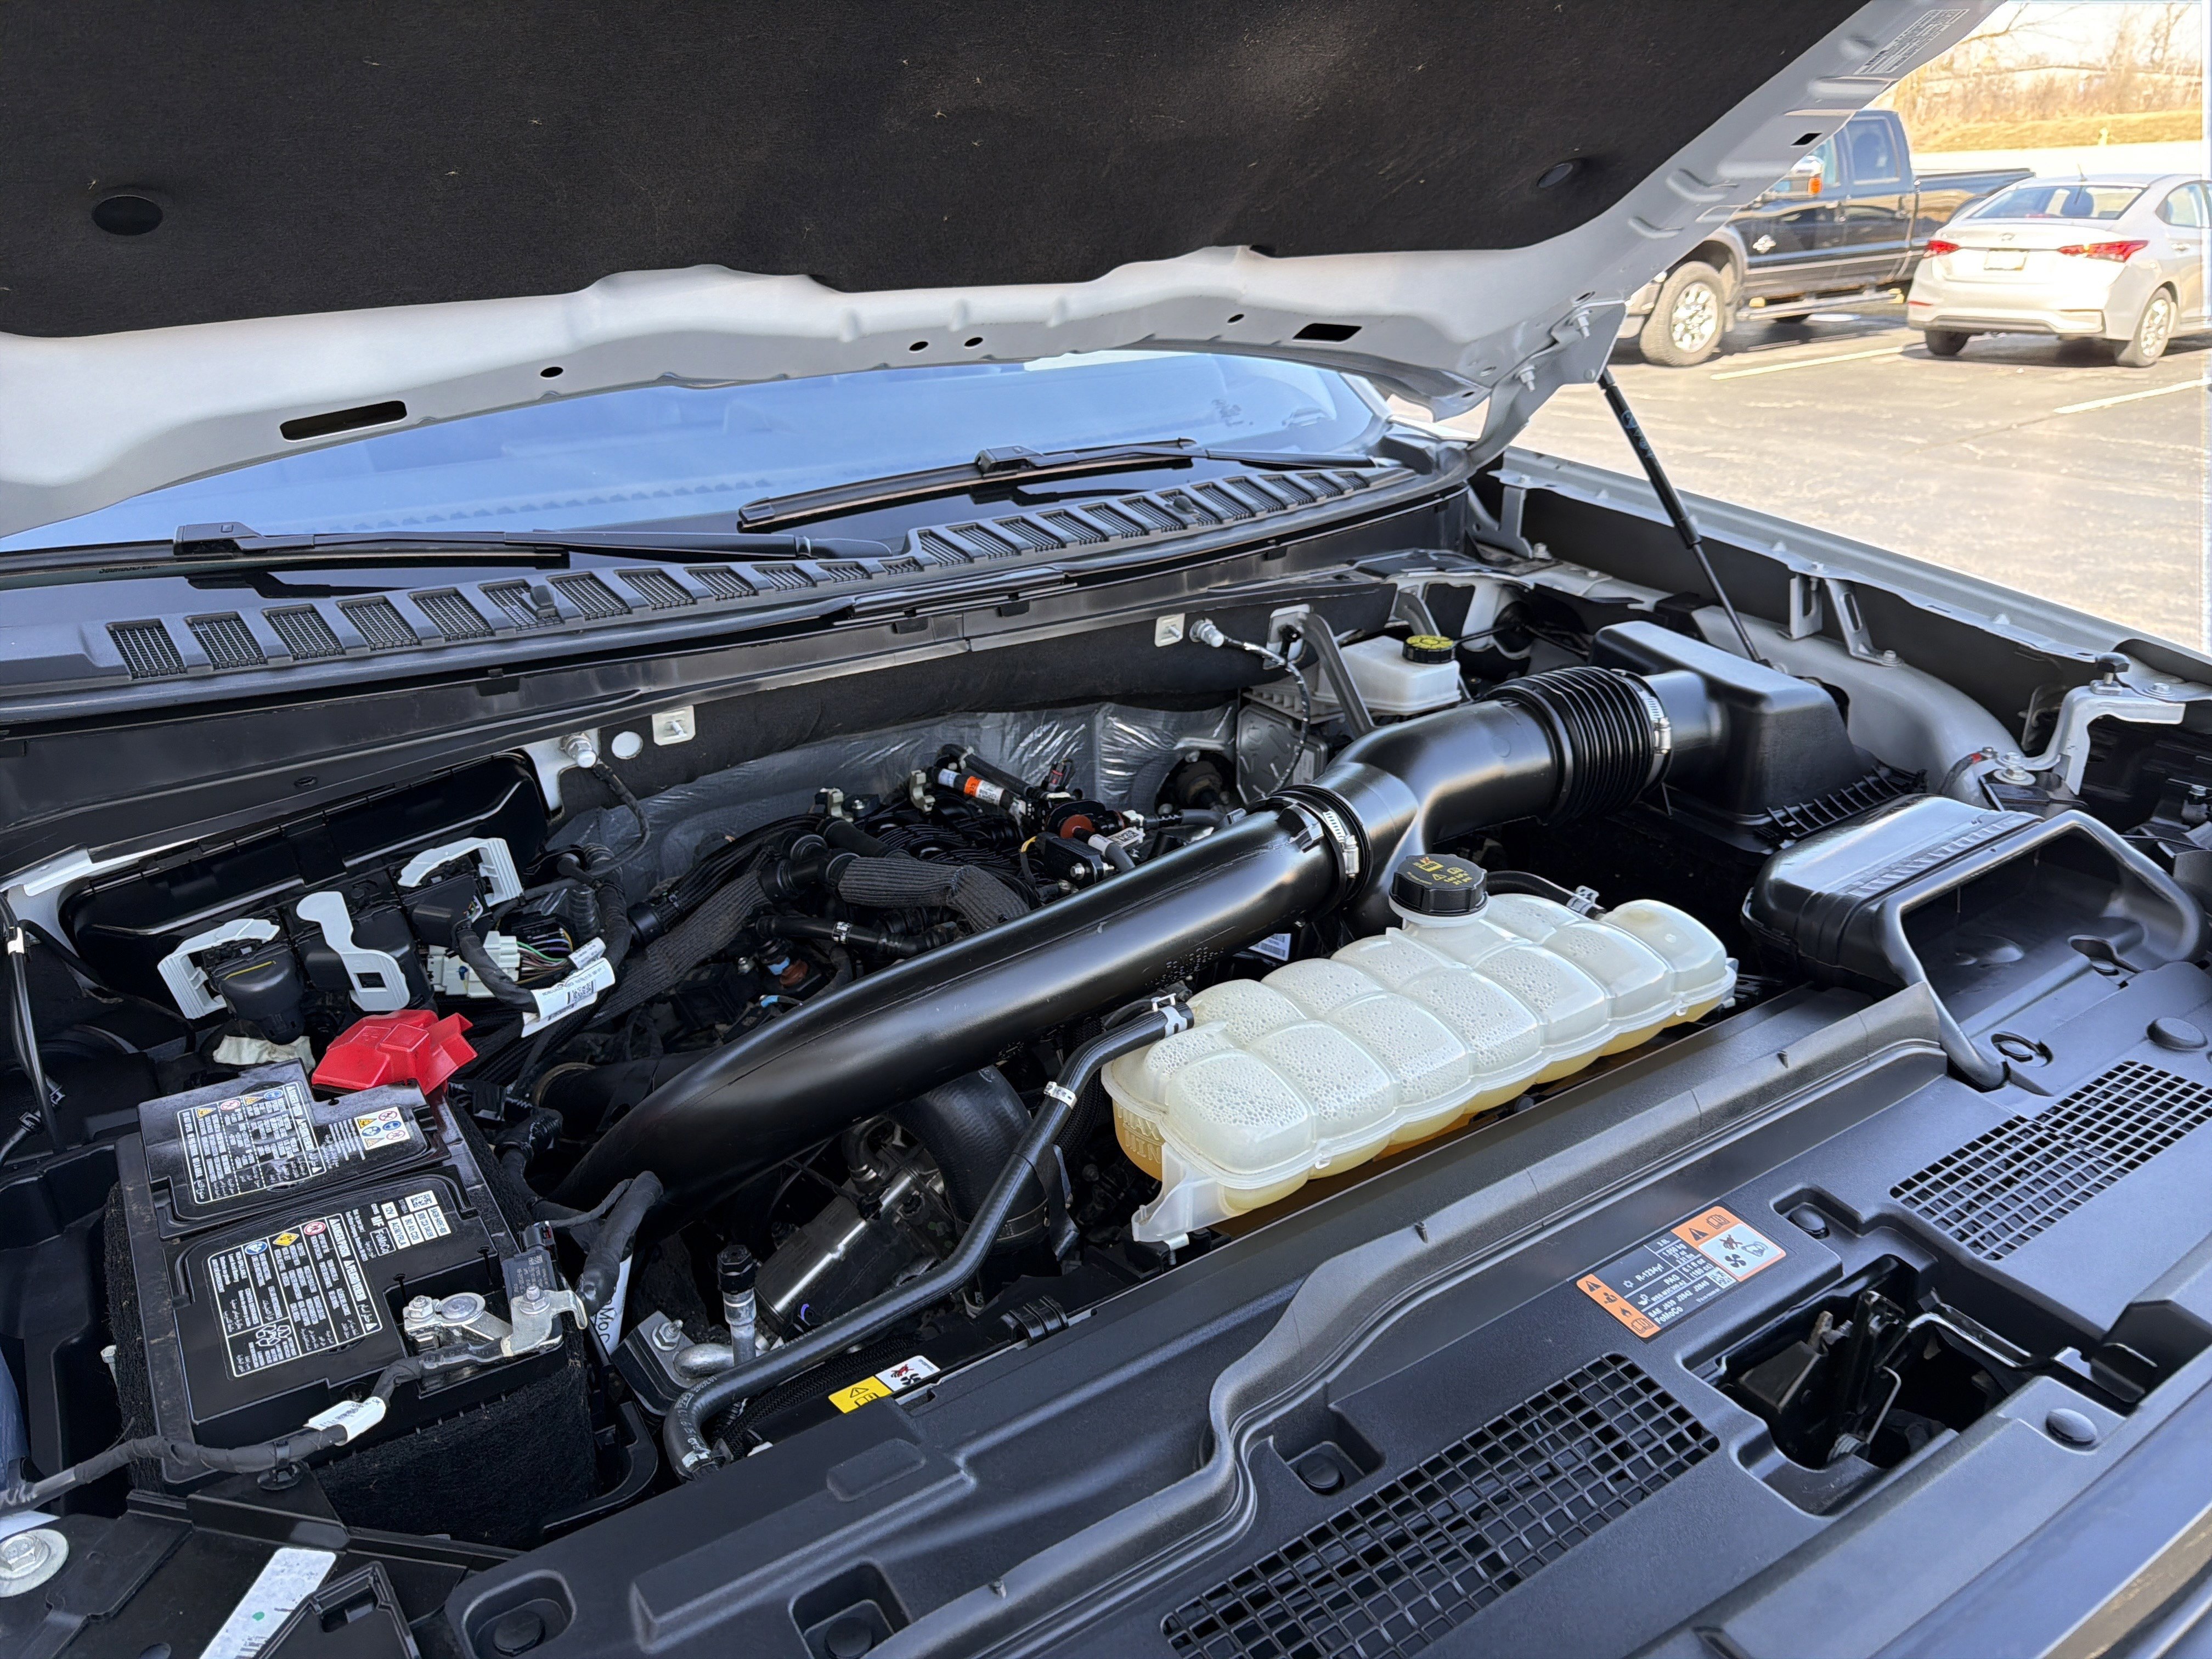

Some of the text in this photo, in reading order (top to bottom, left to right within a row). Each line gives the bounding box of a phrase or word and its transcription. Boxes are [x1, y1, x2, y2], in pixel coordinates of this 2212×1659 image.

[372, 1229, 393, 1254] FoMoCo
[1633, 1262, 1667, 1283] R-1234yf
[1652, 1304, 1685, 1325] FoMoCo
